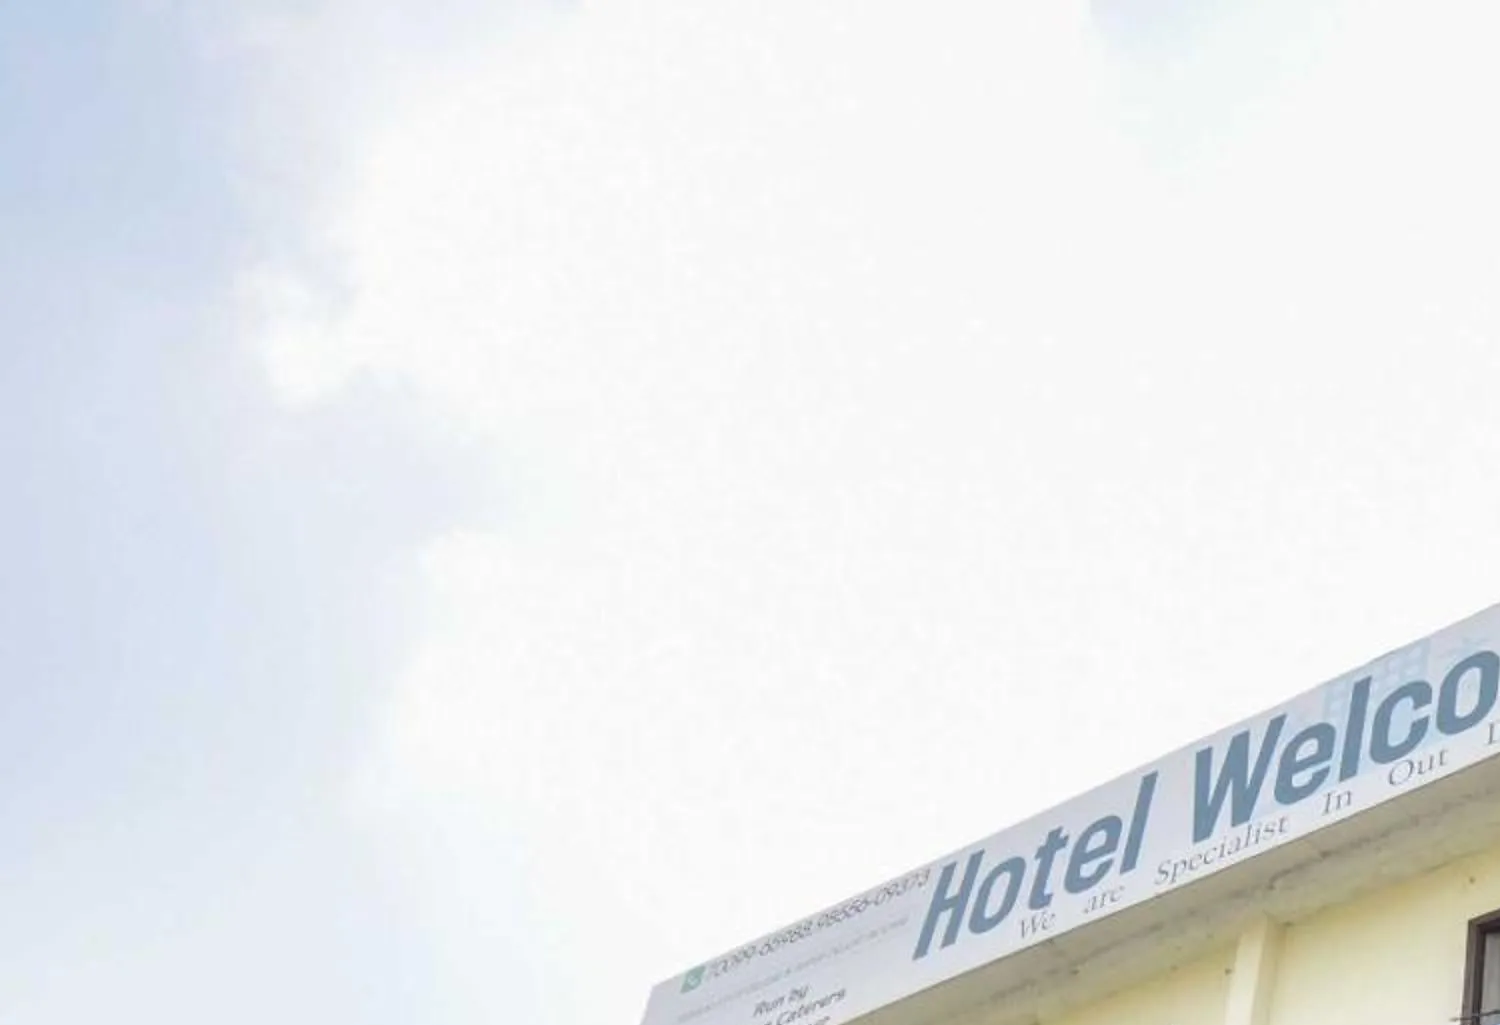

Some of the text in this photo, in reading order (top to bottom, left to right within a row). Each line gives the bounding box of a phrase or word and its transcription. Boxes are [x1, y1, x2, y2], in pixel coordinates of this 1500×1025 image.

[912, 771, 1160, 960] Hotel
[1018, 913, 1058, 940] We
[1082, 885, 1127, 914] are
[1153, 815, 1291, 886] Specialist
[1321, 789, 1354, 817] In
[1387, 745, 1450, 788] Out
[753, 983, 812, 1018] Run by
